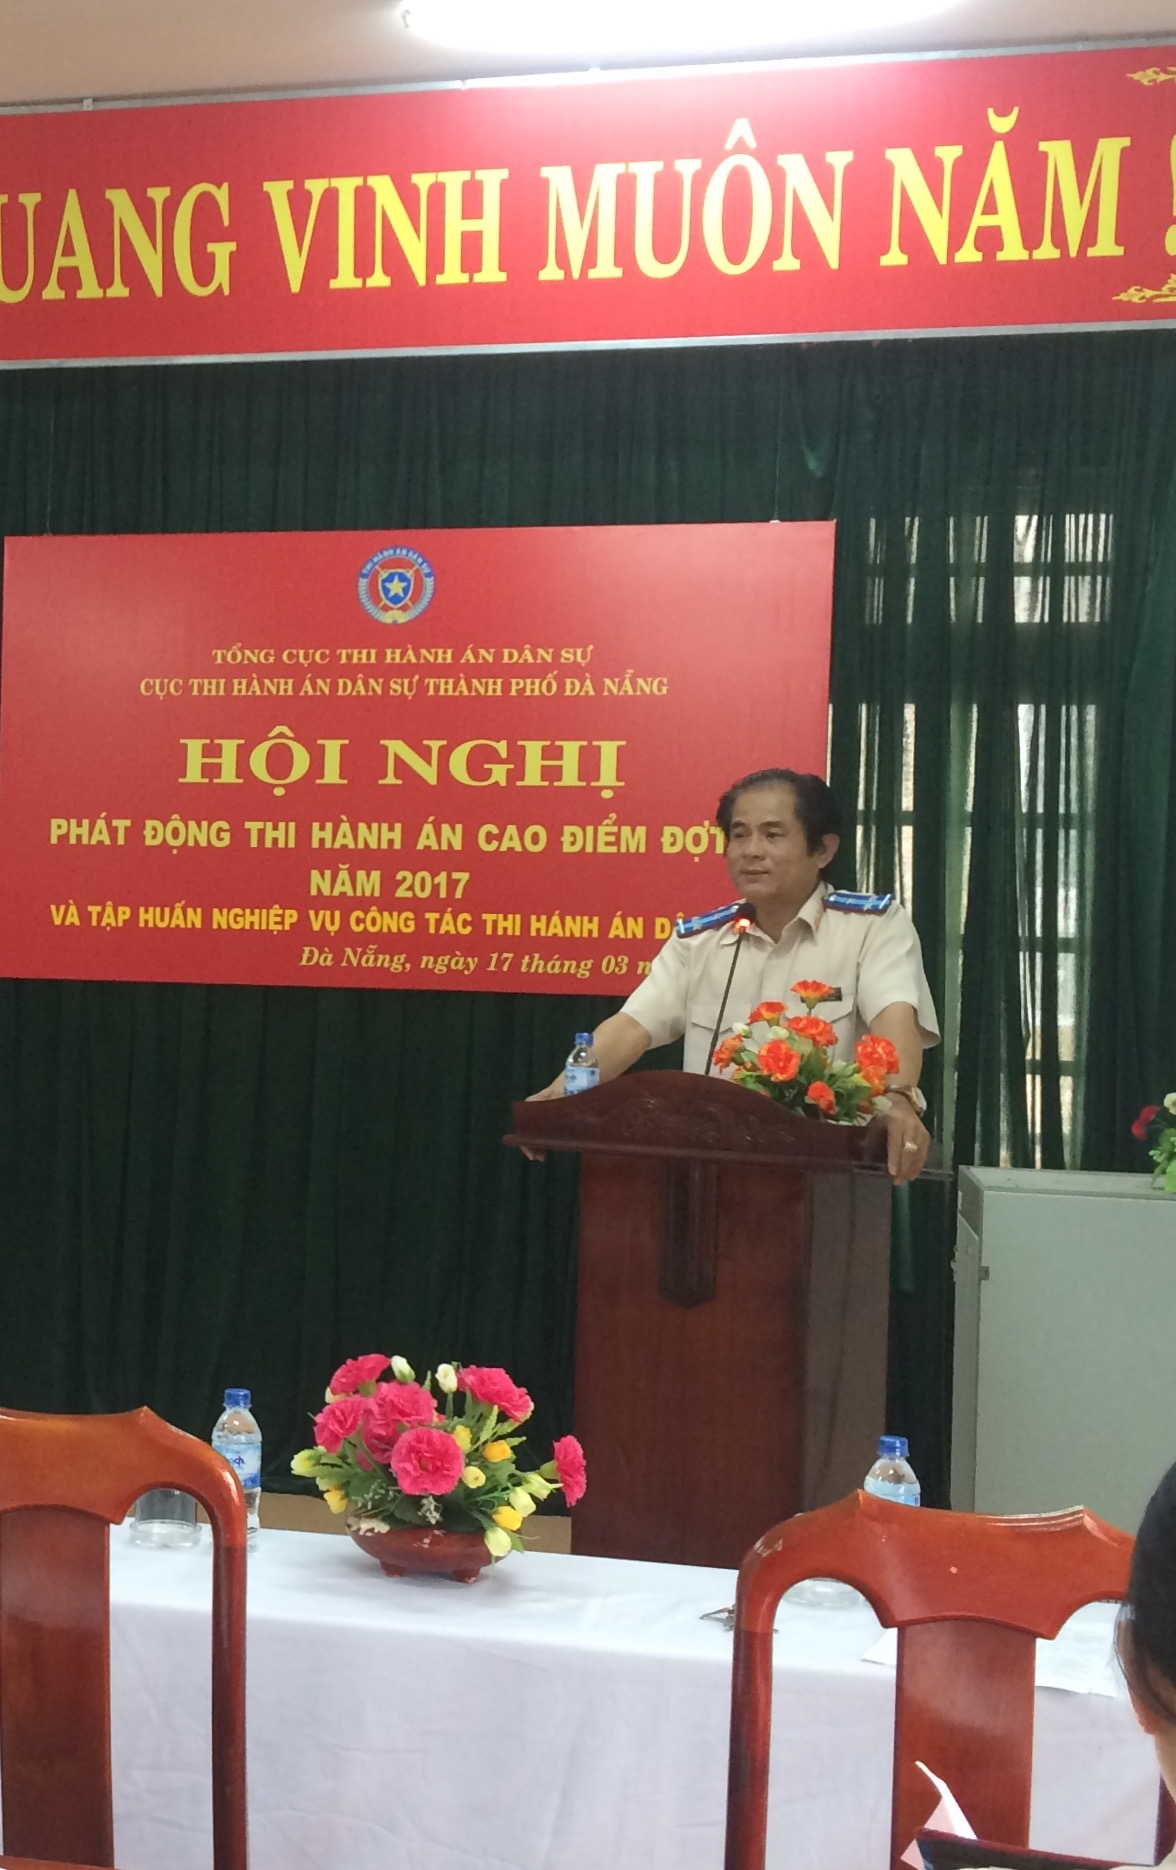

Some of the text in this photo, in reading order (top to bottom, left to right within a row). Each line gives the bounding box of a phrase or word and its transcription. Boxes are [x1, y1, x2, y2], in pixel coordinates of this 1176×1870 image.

[263, 168, 509, 294] VINH
[538, 118, 854, 281] MUÔN
[880, 106, 1131, 266] NĂM
[212, 642, 594, 668] TỔNG CỤC THI HÀNH ÁN DÂN SỰ
[140, 669, 668, 700] CỤC THI HÀNH ÁN DÂN SỰ THÀNH PHỐ ĐÀ NẴNG
[178, 725, 627, 799] HỘI NGHỊ
[50, 812, 131, 846] PHÁT
[143, 814, 231, 854] ĐỘNG
[245, 821, 296, 848] THI
[311, 815, 402, 850] HÀNH
[416, 816, 463, 851] ÁN
[478, 824, 548, 852] CAO
[561, 812, 647, 854] ĐIỂM
[309, 864, 470, 899] NĂM 2017
[50, 899, 81, 926] VÀ
[87, 900, 131, 931] TẬP
[139, 900, 202, 929] HUẤN
[212, 904, 298, 935] NGHIỆP
[308, 909, 341, 937] VỤ
[349, 905, 416, 933] CÔNG
[424, 907, 473, 935] TÁC
[481, 913, 521, 936] THI
[608, 910, 644, 939] ÁN
[299, 946, 335, 967] Đà
[340, 944, 412, 973] Nẵng,
[419, 950, 479, 975] ngày
[486, 952, 514, 972] 17
[520, 953, 594, 979] tháng
[601, 955, 629, 975] 03
